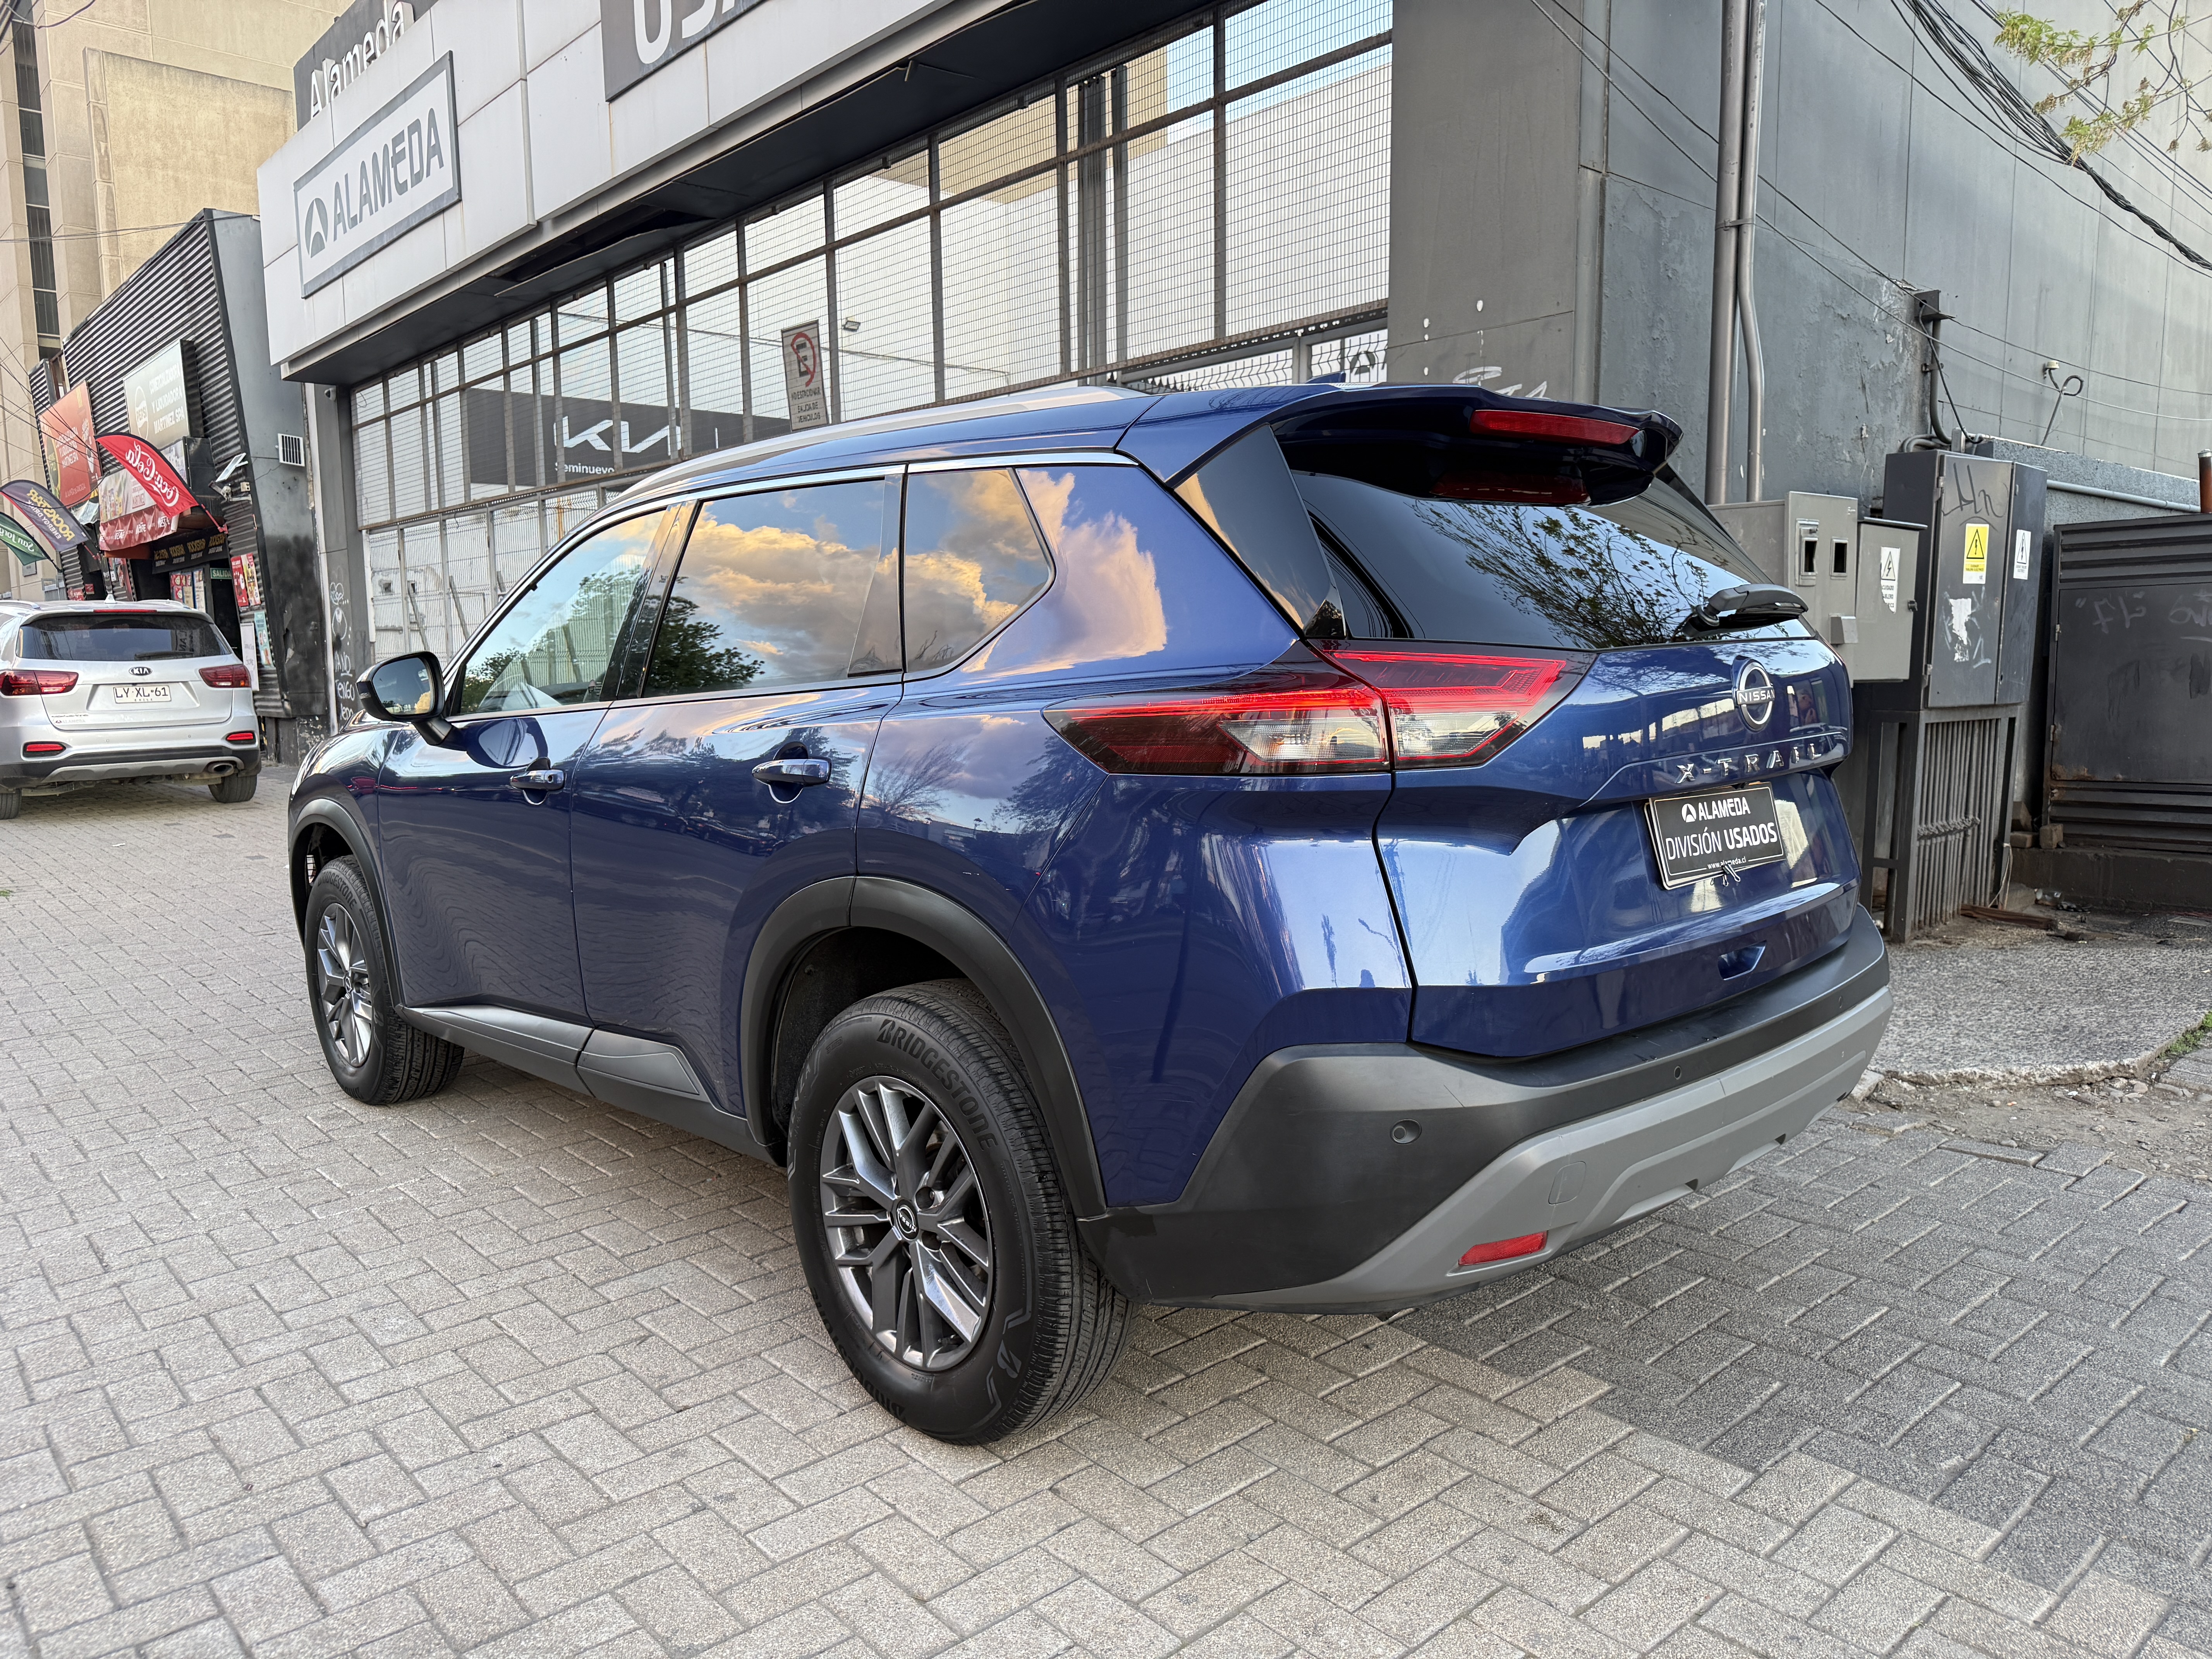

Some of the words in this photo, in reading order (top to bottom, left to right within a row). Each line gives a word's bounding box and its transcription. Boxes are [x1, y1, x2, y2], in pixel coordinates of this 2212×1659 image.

[333, 108, 444, 242] ALAMEDA
[154, 410, 175, 434] MARTINEZ
[1739, 690, 1775, 703] NISSAN
[1674, 743, 1822, 783] X-TRAIL
[1698, 797, 1750, 821] ALAMEDA
[1666, 826, 1722, 860] DIVISIÓN
[1724, 822, 1778, 850] USADOS
[876, 1019, 999, 1151] BRIDGESTONE
